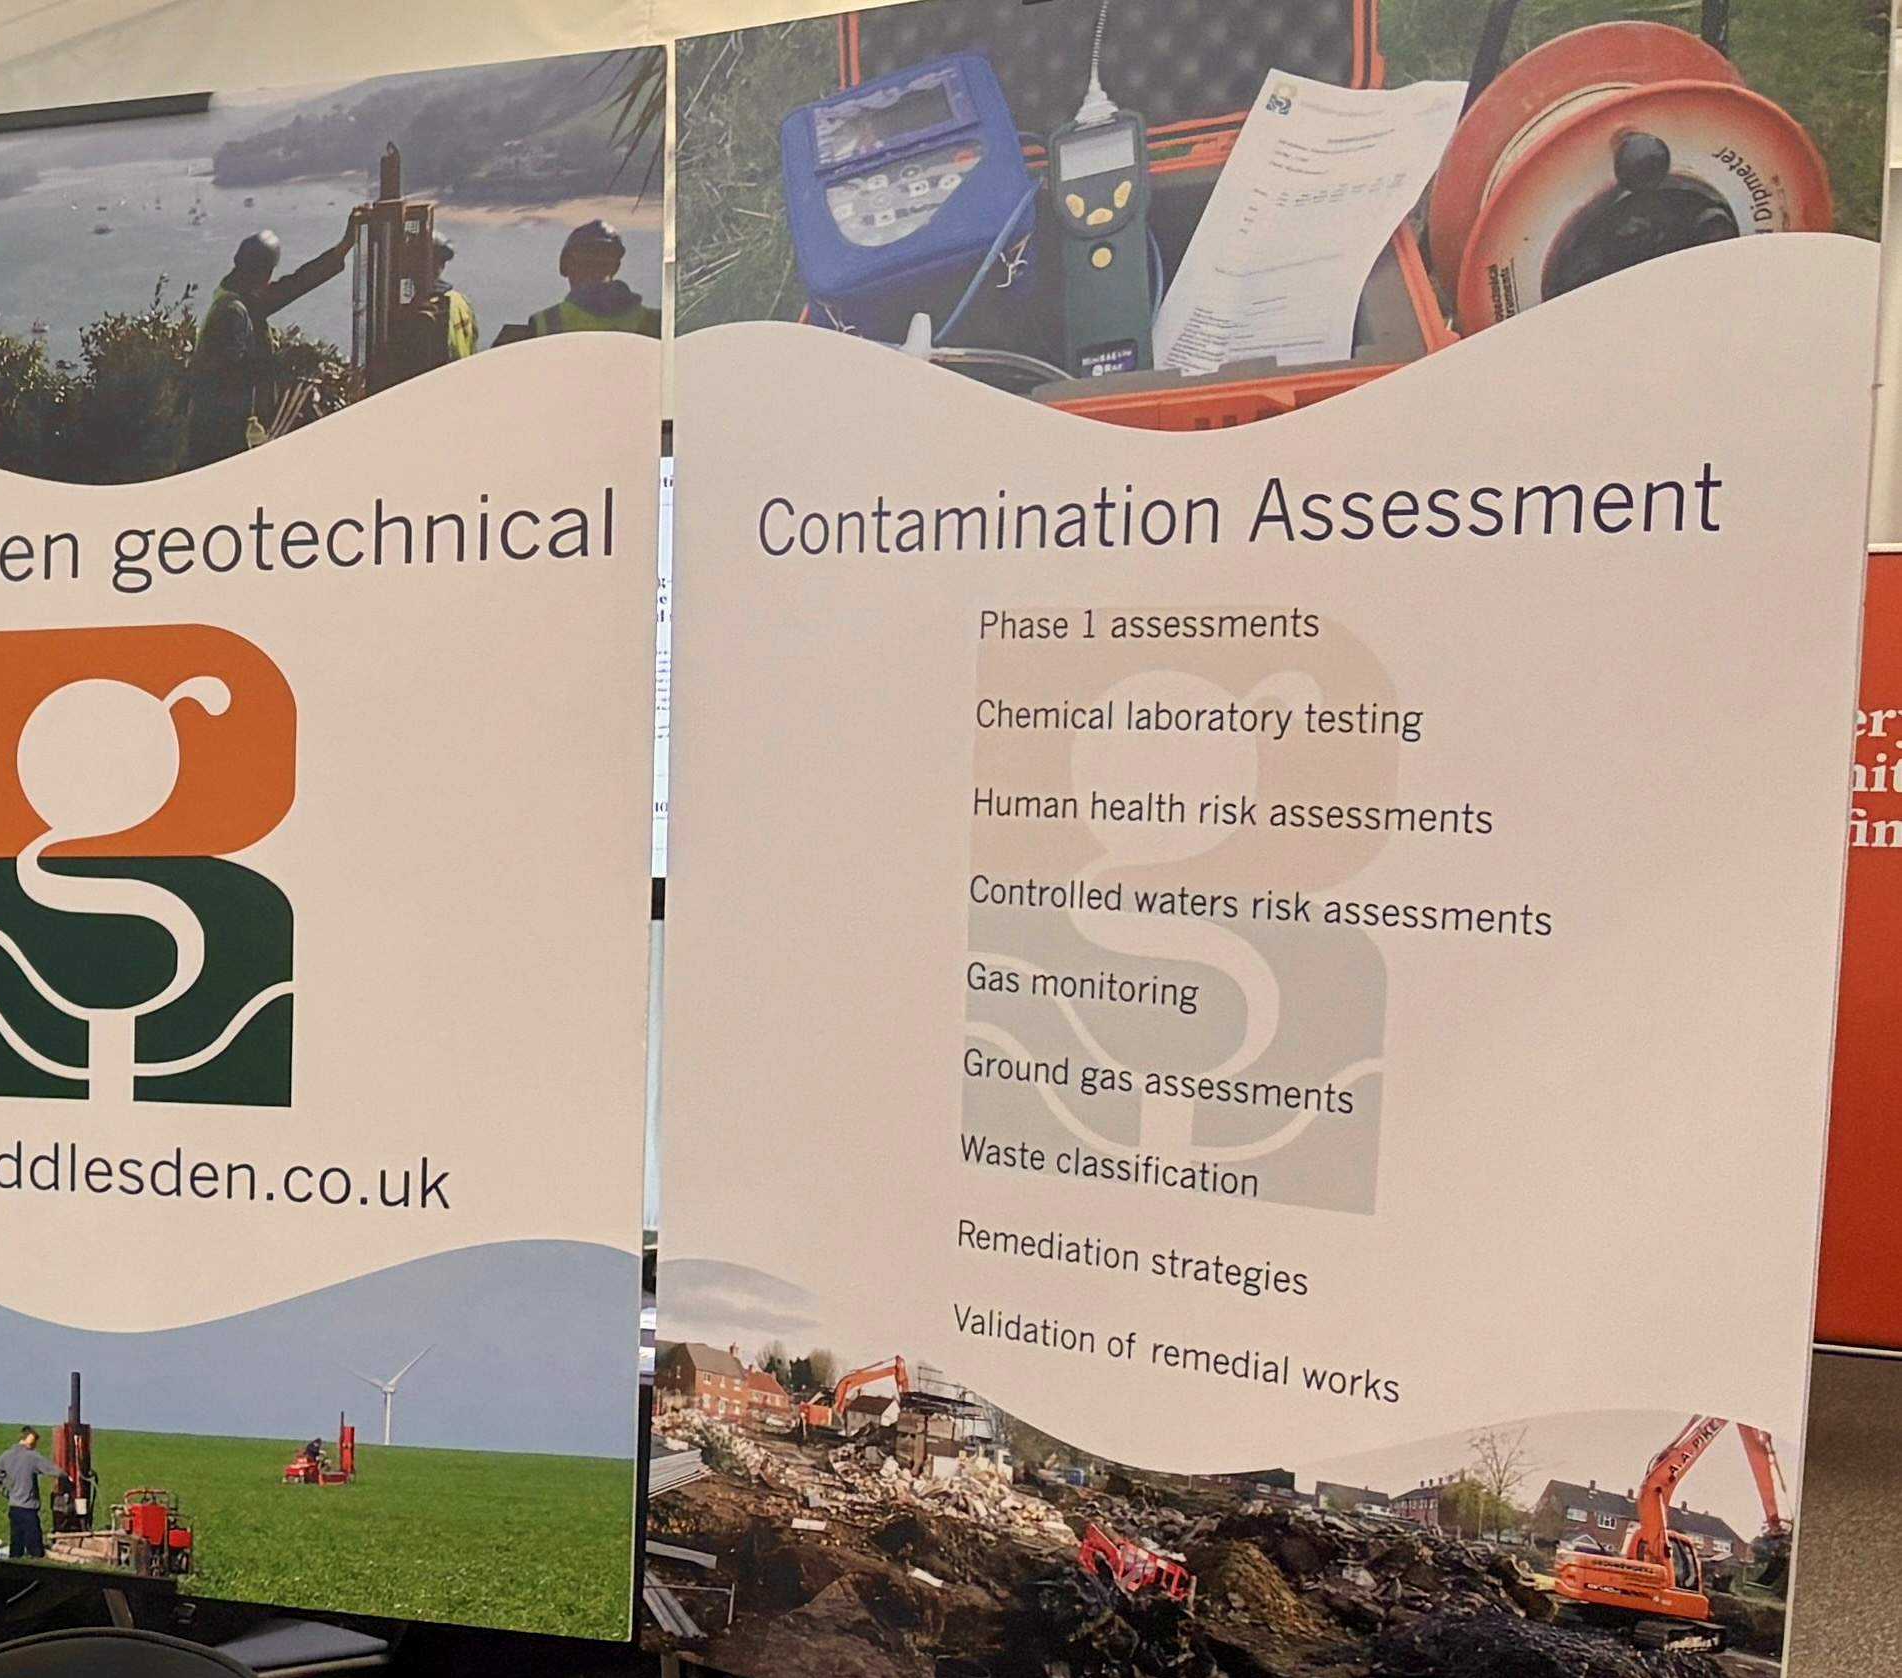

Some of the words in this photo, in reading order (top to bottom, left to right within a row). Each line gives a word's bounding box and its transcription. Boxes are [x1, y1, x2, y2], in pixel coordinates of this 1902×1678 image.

[1713, 146, 1773, 222] Dipmeter
[110, 487, 615, 594] geotechnical
[758, 489, 1222, 556] Contamination
[1251, 463, 1722, 542] Assessment
[982, 611, 1069, 640] Phase
[1084, 610, 1096, 639] 1
[1112, 609, 1326, 639] assessments
[978, 700, 1114, 731] Chemical
[1128, 702, 1294, 741] laboratory
[1306, 704, 1427, 743] testing
[1855, 708, 1902, 749] er
[975, 788, 1078, 820] Human
[1092, 792, 1186, 824] health
[1201, 796, 1258, 826] risk
[1271, 804, 1498, 835] assessments
[971, 876, 1122, 912] Controlled
[1135, 887, 1239, 919] waters
[1253, 891, 1313, 923] risk
[1326, 902, 1554, 937] assessments
[968, 962, 1020, 994] Gas
[1033, 973, 1200, 1016] monitoring
[965, 1049, 1069, 1086] Ground
[1081, 1068, 1133, 1096] gas
[1144, 1078, 1357, 1115] assessments
[962, 1135, 1046, 1172] Waste
[1058, 1148, 1259, 1198] classification
[959, 1220, 1139, 1273] Remediation
[1153, 1250, 1309, 1297] strategies
[955, 1305, 1096, 1354] Validation
[1108, 1333, 1137, 1360] of
[1153, 1344, 1289, 1386] remedial
[1304, 1368, 1400, 1404] works
